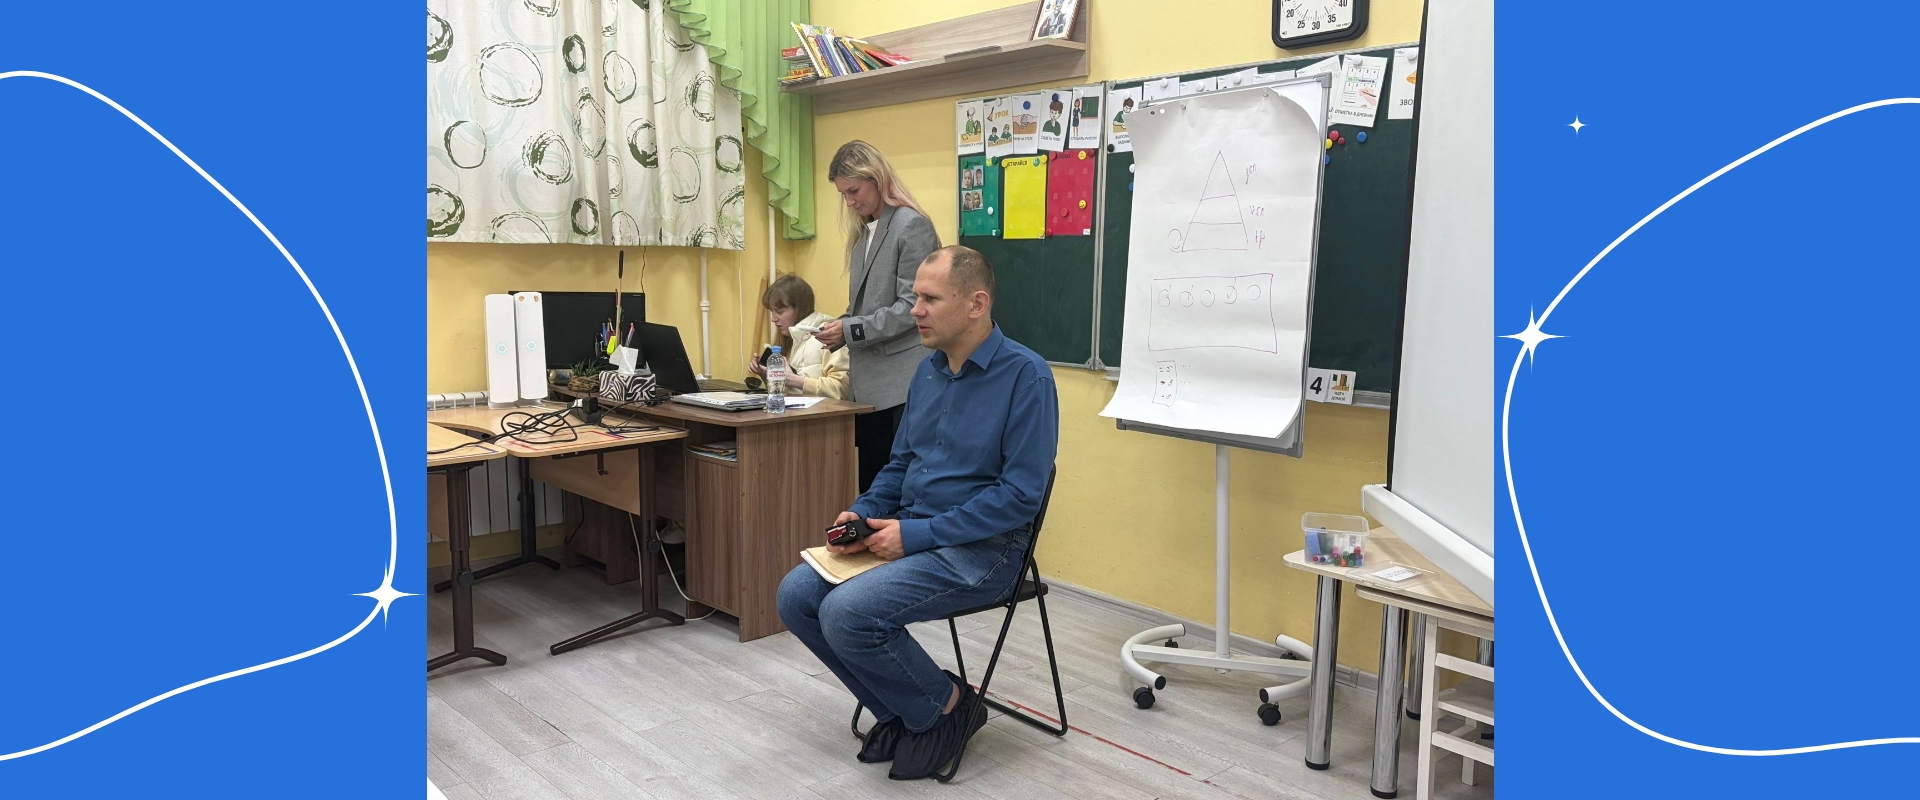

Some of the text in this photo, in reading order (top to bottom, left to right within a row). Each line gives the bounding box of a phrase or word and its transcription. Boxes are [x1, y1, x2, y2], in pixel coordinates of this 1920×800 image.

[1286, 8, 1295, 18] 20
[1327, 13, 1337, 24] 35
[1297, 19, 1306, 29] 25
[1311, 20, 1321, 31] 30
[1399, 98, 1413, 106] ЗВО
[994, 109, 1009, 119] УРОК
[1309, 376, 1323, 395] 4
